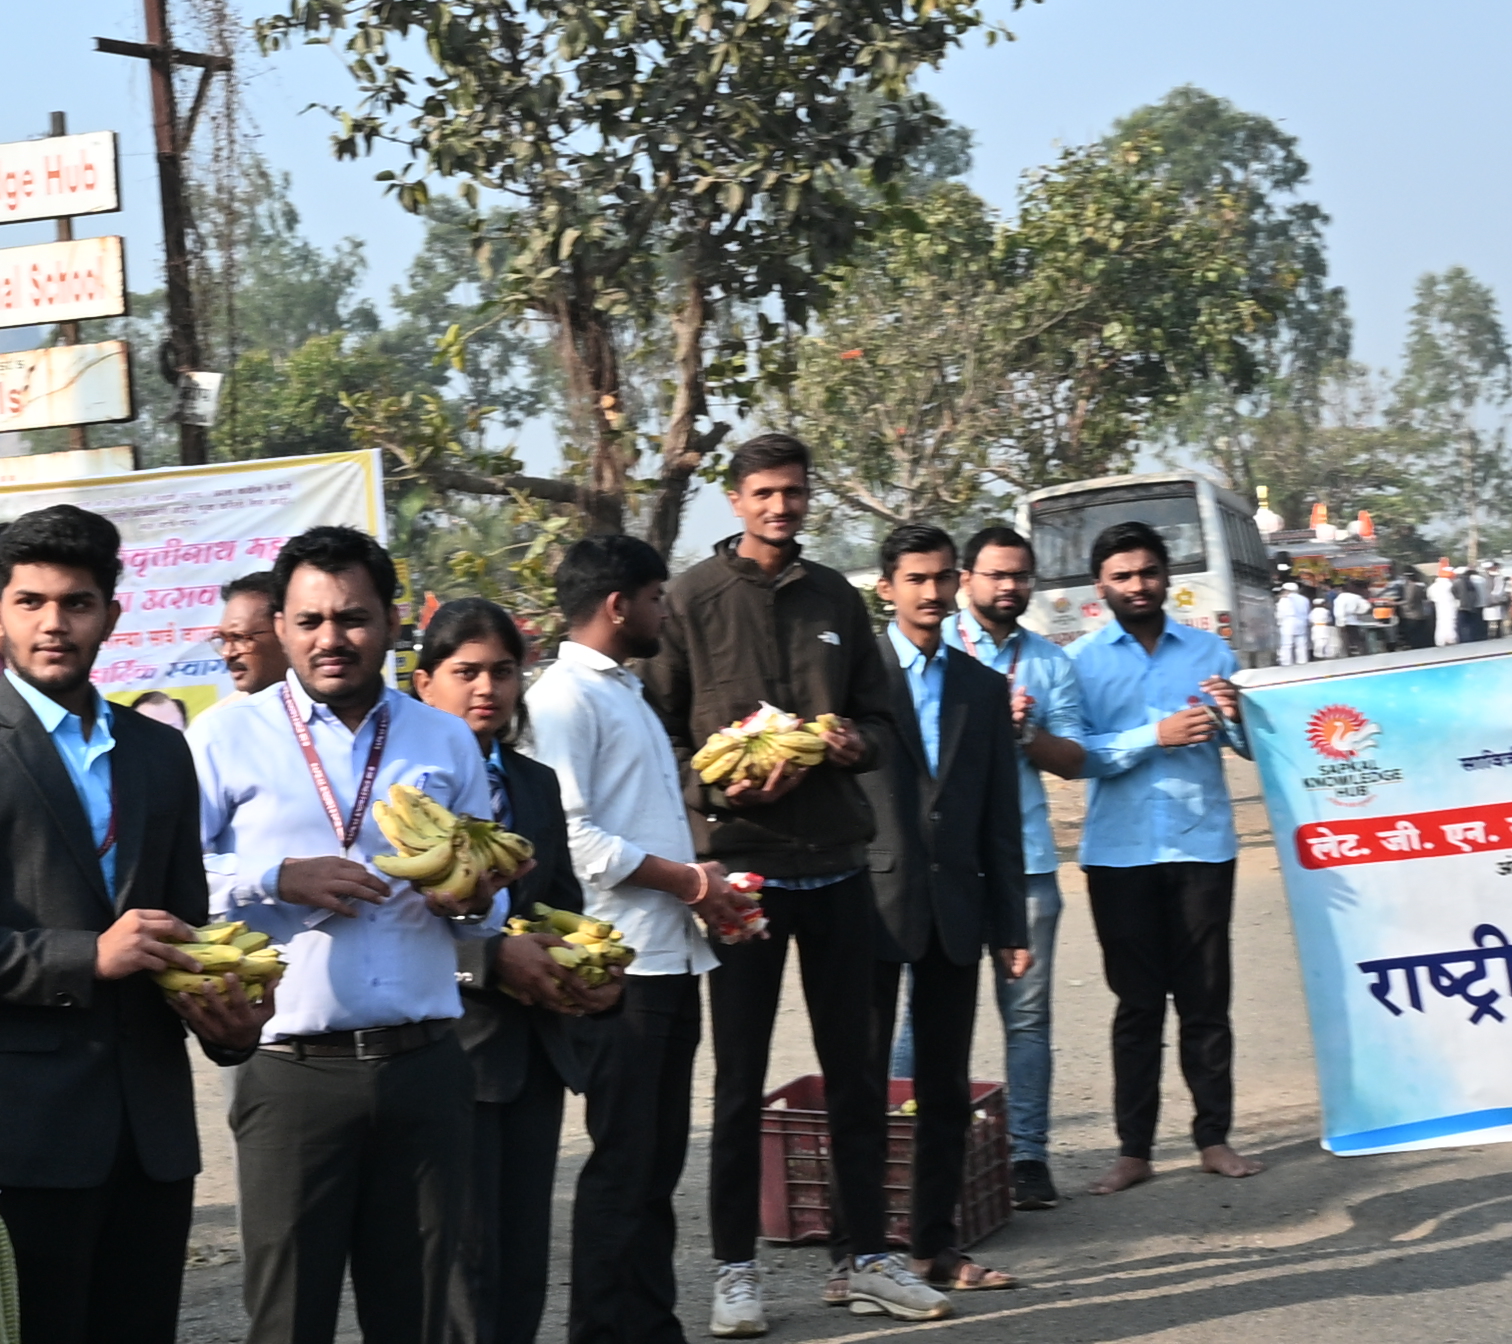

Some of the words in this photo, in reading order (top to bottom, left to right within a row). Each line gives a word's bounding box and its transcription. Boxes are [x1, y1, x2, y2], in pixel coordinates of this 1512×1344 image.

[44, 148, 96, 196] Hub
[29, 255, 107, 307] School
[117, 537, 239, 578] वृत्तीनाथ
[1302, 767, 1404, 789] KNOWLEDGE
[1335, 785, 1370, 798] HUB
[1306, 826, 1373, 861] लेट.
[1376, 820, 1436, 853] जी.
[1439, 820, 1501, 854] एन.
